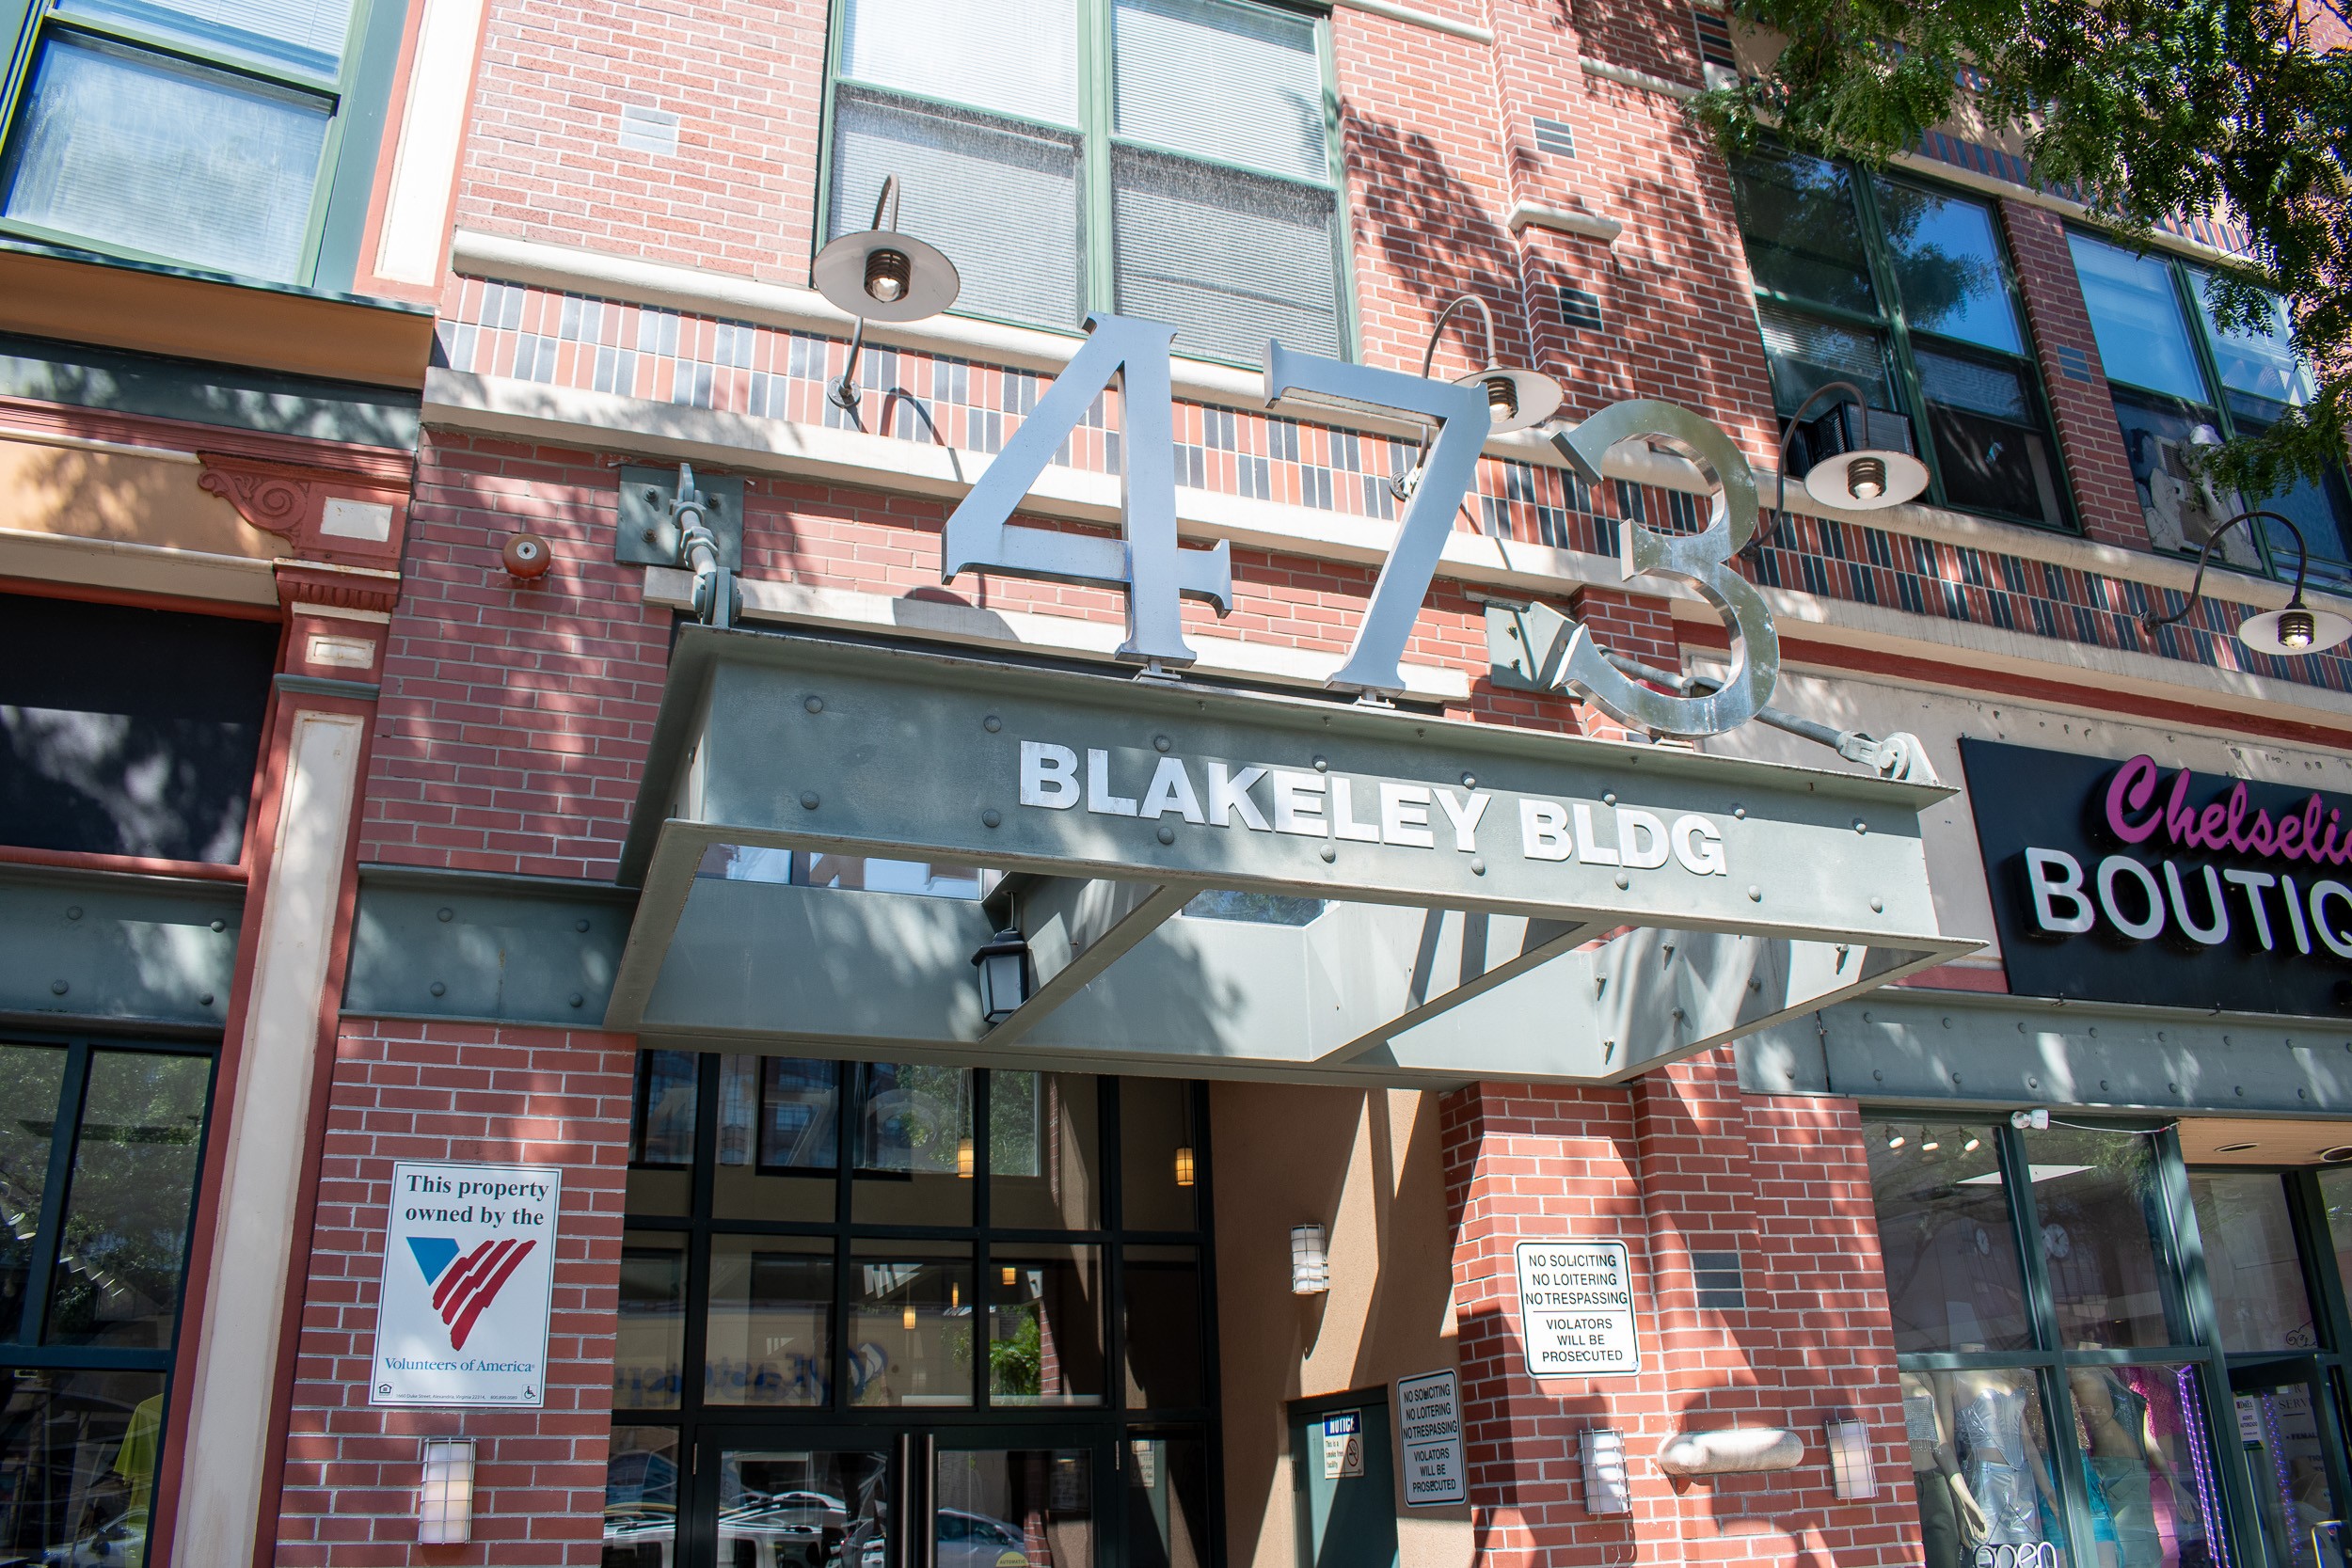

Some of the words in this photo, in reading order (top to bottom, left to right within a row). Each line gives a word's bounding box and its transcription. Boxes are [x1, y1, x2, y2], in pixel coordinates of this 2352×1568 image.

[941, 311, 1779, 739] 473
[1020, 741, 1491, 853] BLAKELEY
[1518, 798, 1727, 877] BLDG
[406, 1175, 452, 1194] This
[457, 1180, 549, 1201] property
[405, 1206, 473, 1223] owned
[480, 1206, 506, 1228] by
[512, 1208, 544, 1226] the
[1529, 1255, 1546, 1267] NO
[1549, 1255, 1617, 1267] SOLICITING
[1532, 1274, 1550, 1286] NO
[1553, 1273, 1617, 1286] LOITERING
[1525, 1292, 1543, 1305] NO
[1544, 1291, 1629, 1305] TRESPASSING
[1546, 1319, 1613, 1330] VIOLATORS
[1557, 1335, 1586, 1346] WILL
[1589, 1334, 1605, 1345] BE
[1542, 1350, 1623, 1362] PROSECUTED
[385, 1357, 457, 1371] Volunteers
[460, 1359, 476, 1371] of
[1404, 1390, 1413, 1403] NO
[1414, 1384, 1451, 1400] SOLICITING
[1406, 1408, 1415, 1421] NO
[1417, 1402, 1452, 1419] LOITERING
[1329, 1415, 1355, 1434] NOTICE
[1403, 1426, 1412, 1439] NO
[1412, 1420, 1457, 1438] TRESPASSING
[1414, 1448, 1450, 1462] VIOLATORS
[1420, 1465, 1436, 1477] WILL
[1437, 1464, 1446, 1476] BE
[1412, 1479, 1456, 1494] PROSECUTED
